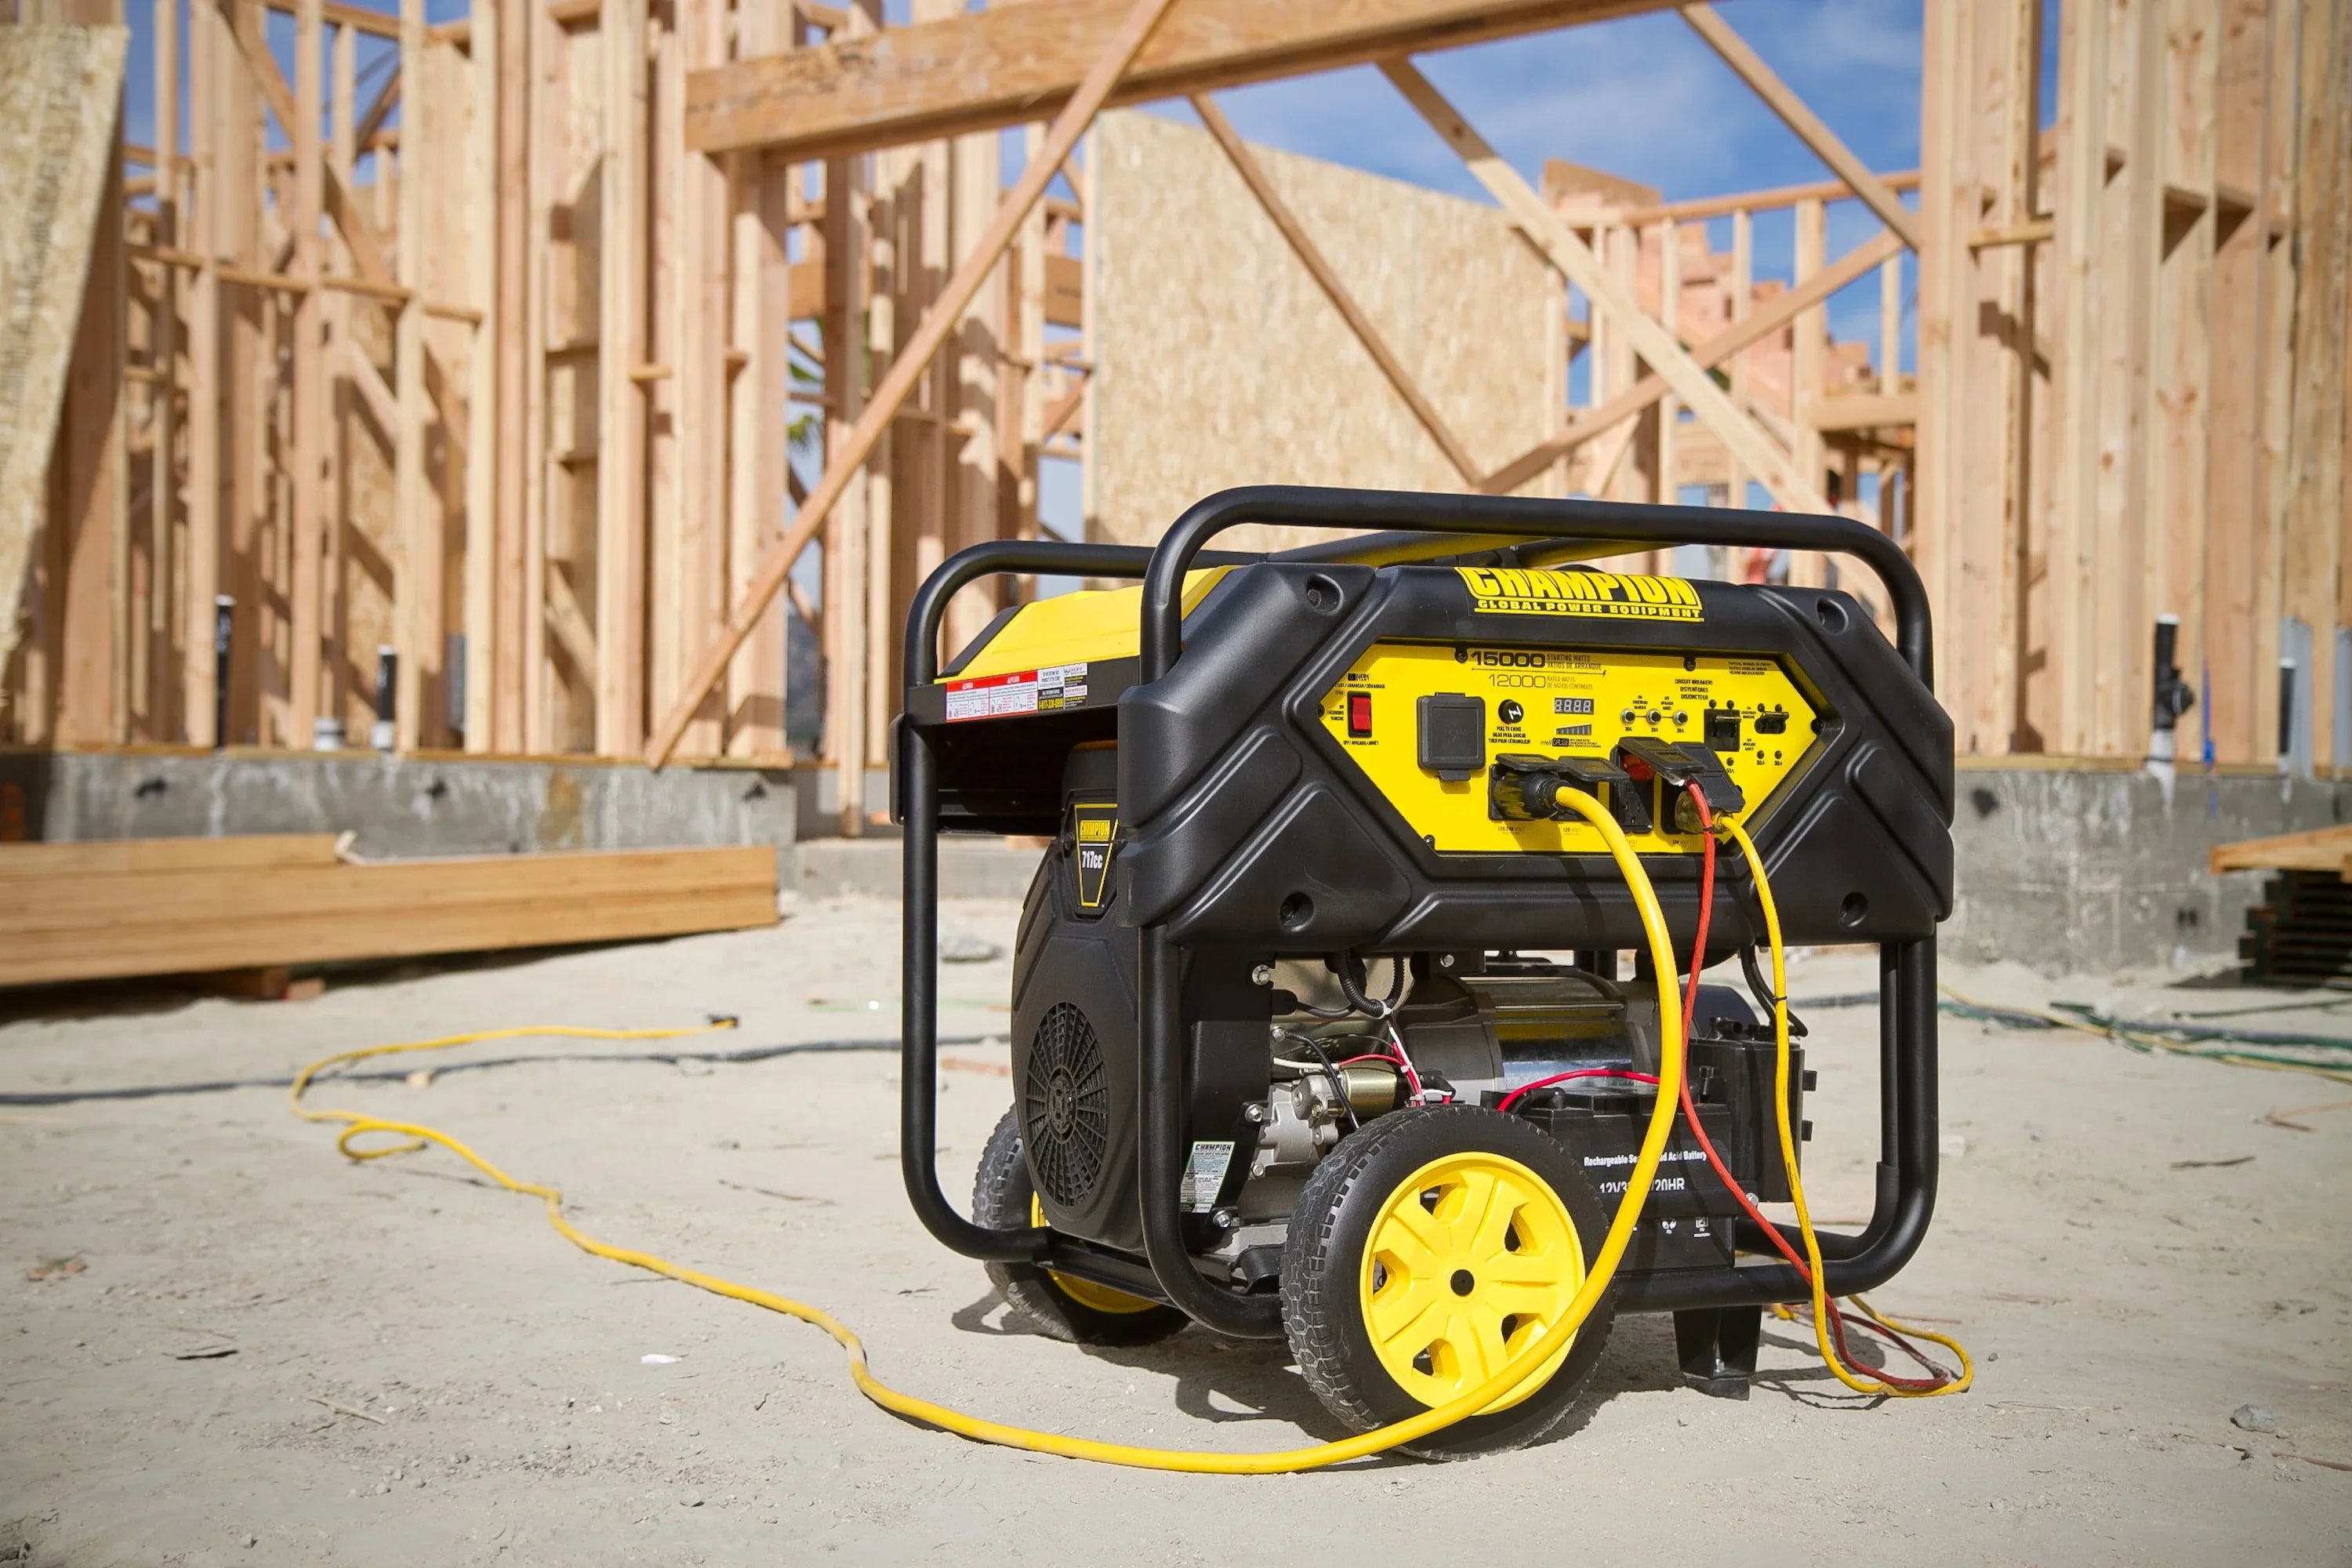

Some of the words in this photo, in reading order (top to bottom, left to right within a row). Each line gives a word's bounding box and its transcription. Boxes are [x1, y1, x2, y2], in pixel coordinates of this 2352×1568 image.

[1461, 568, 1697, 604] CHAMPION
[1478, 599, 1541, 611] GLOBAL
[1547, 603, 1602, 613] POWER
[1610, 605, 1700, 618] EQUIPMENT
[1470, 651, 1546, 668] 15000
[1547, 654, 1573, 662] STARTING
[1488, 674, 1546, 688] 12000
[1082, 851, 1103, 869] 717cc
[1584, 1155, 1628, 1167] Rechargeable
[1668, 1151, 1683, 1161] Acid
[1683, 1150, 1708, 1162] Battery
